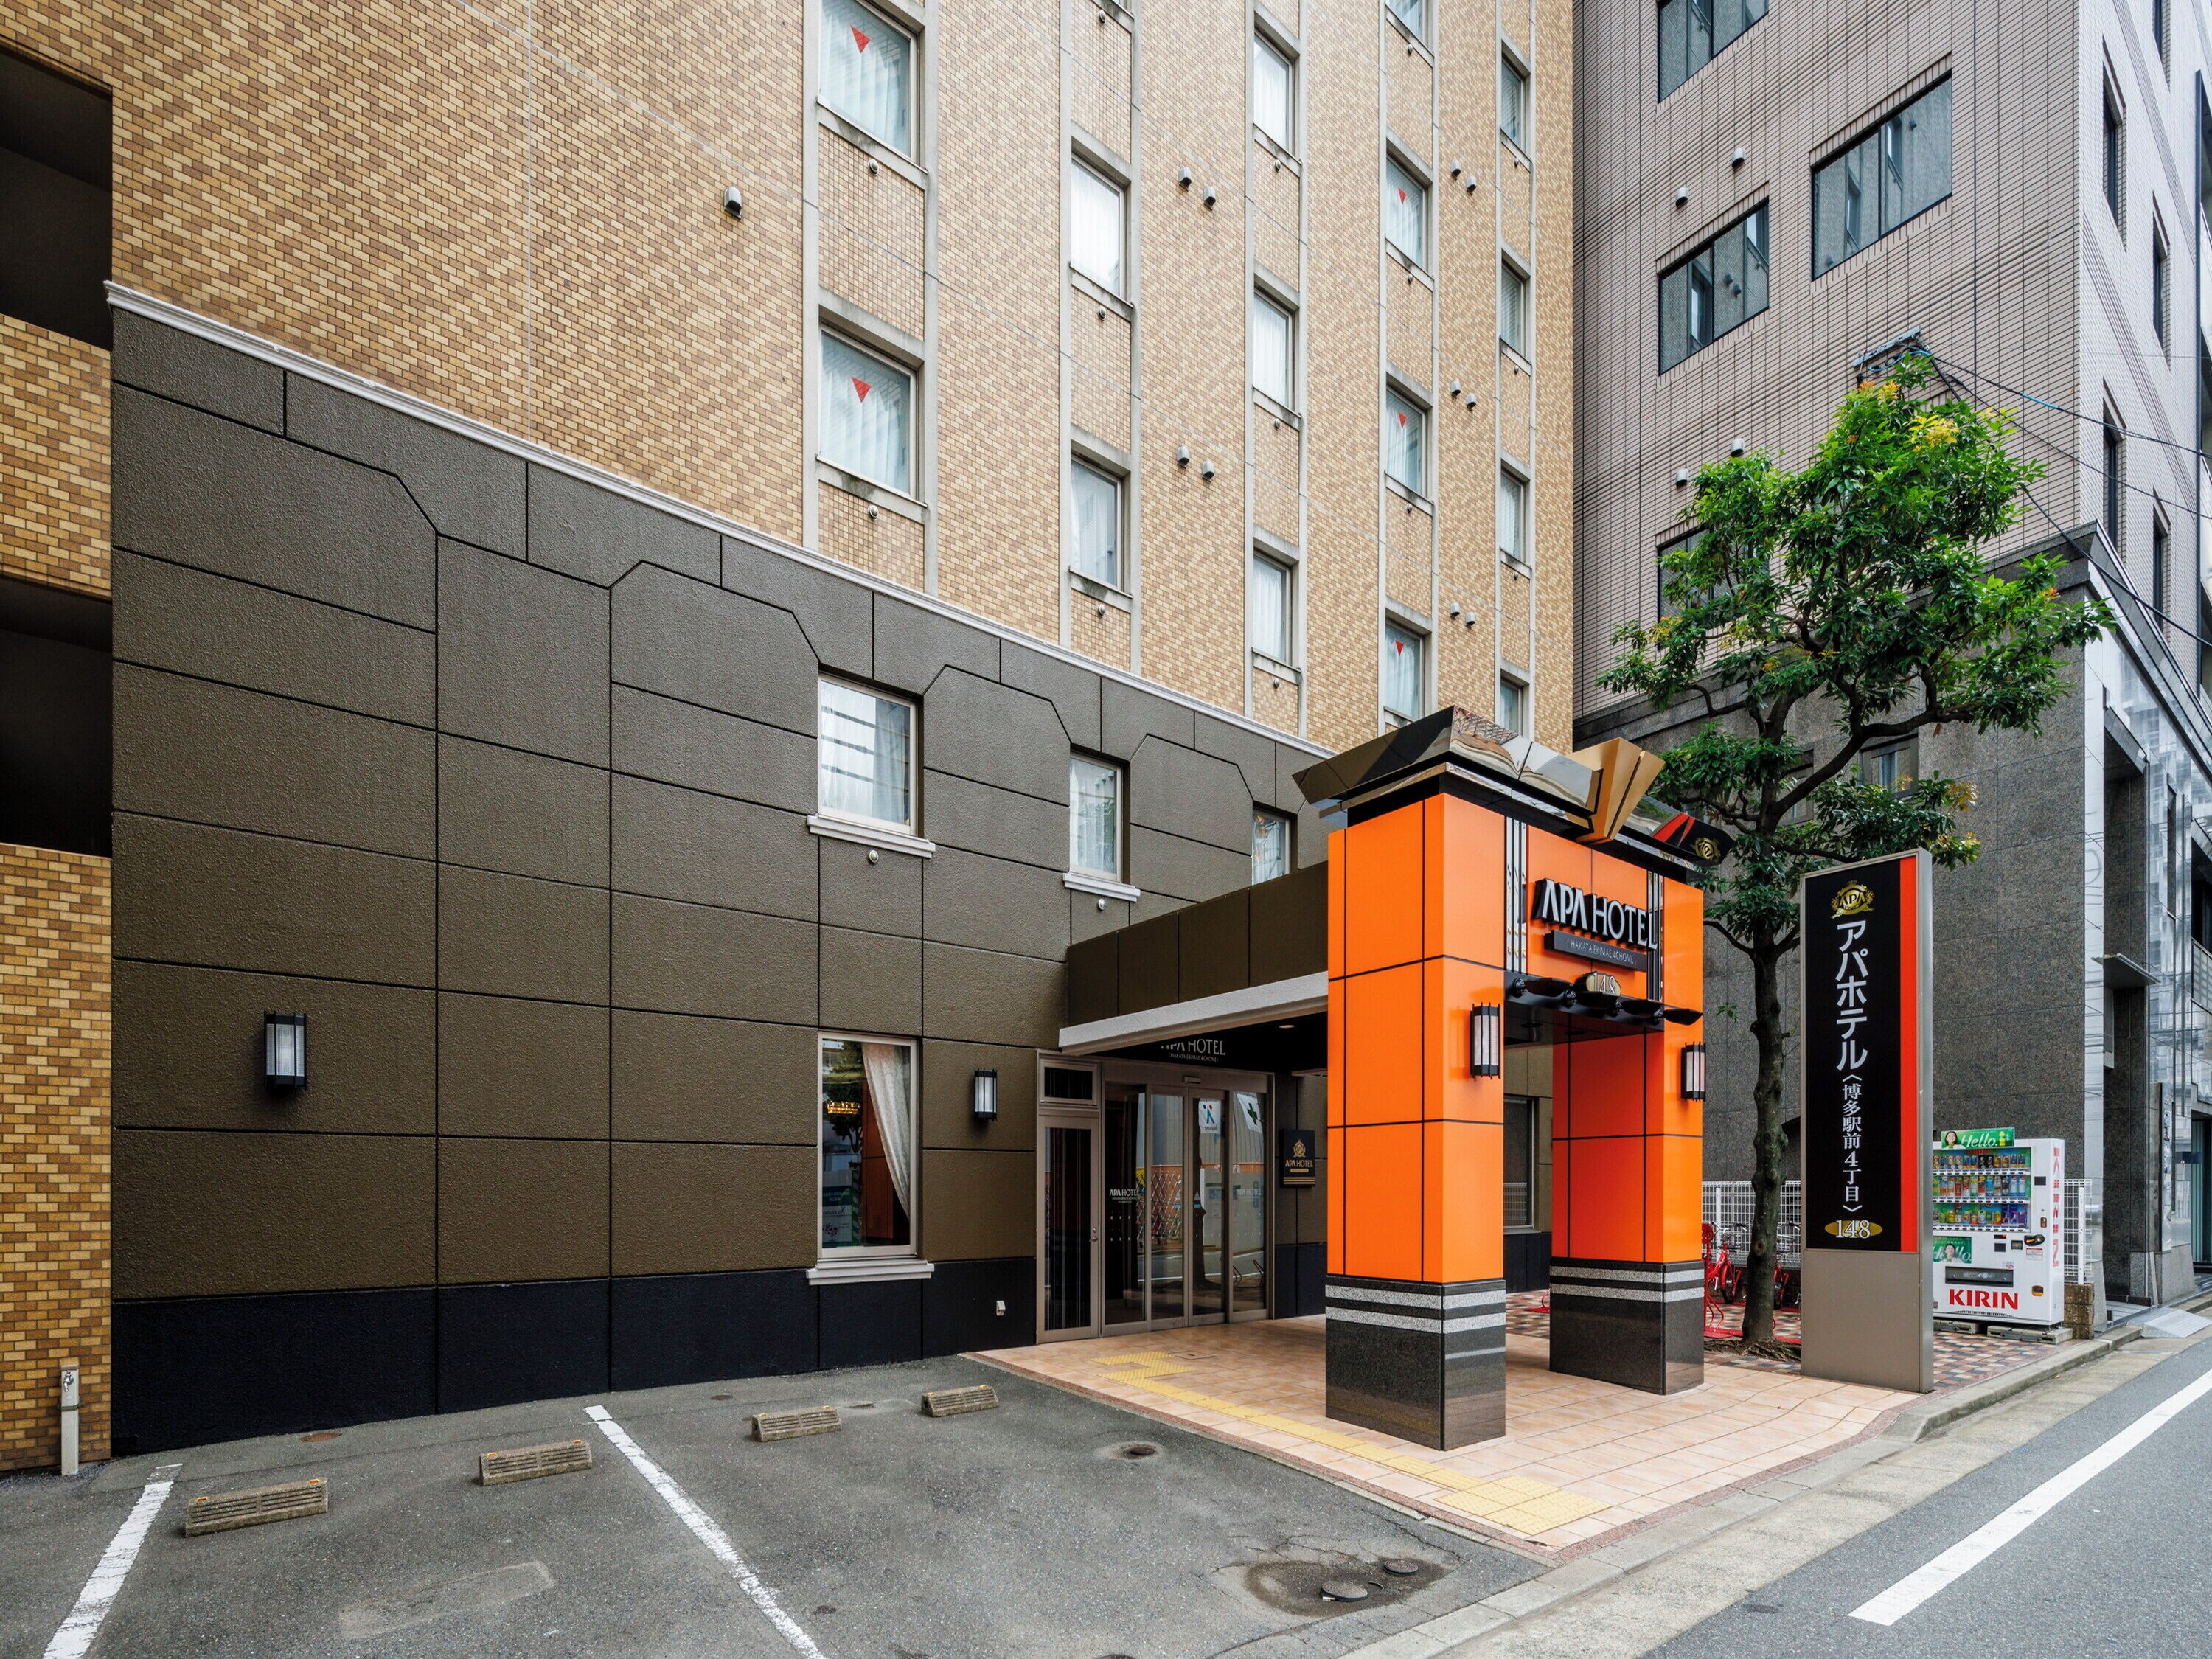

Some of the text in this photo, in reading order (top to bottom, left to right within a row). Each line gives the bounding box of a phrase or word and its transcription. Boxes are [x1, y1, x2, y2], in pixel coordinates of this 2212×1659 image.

[1542, 880, 1658, 950] APA HOTEL
[1593, 973, 1616, 995] 148
[1835, 920, 1868, 1070] アパホテル
[1188, 1038, 1225, 1055] HOTEL
[1961, 1133, 1998, 1147] Hello.
[1285, 1160, 1313, 1168] APA HOTEL
[1835, 1220, 1871, 1239] 148
[1949, 1289, 2019, 1310] KIRIN
